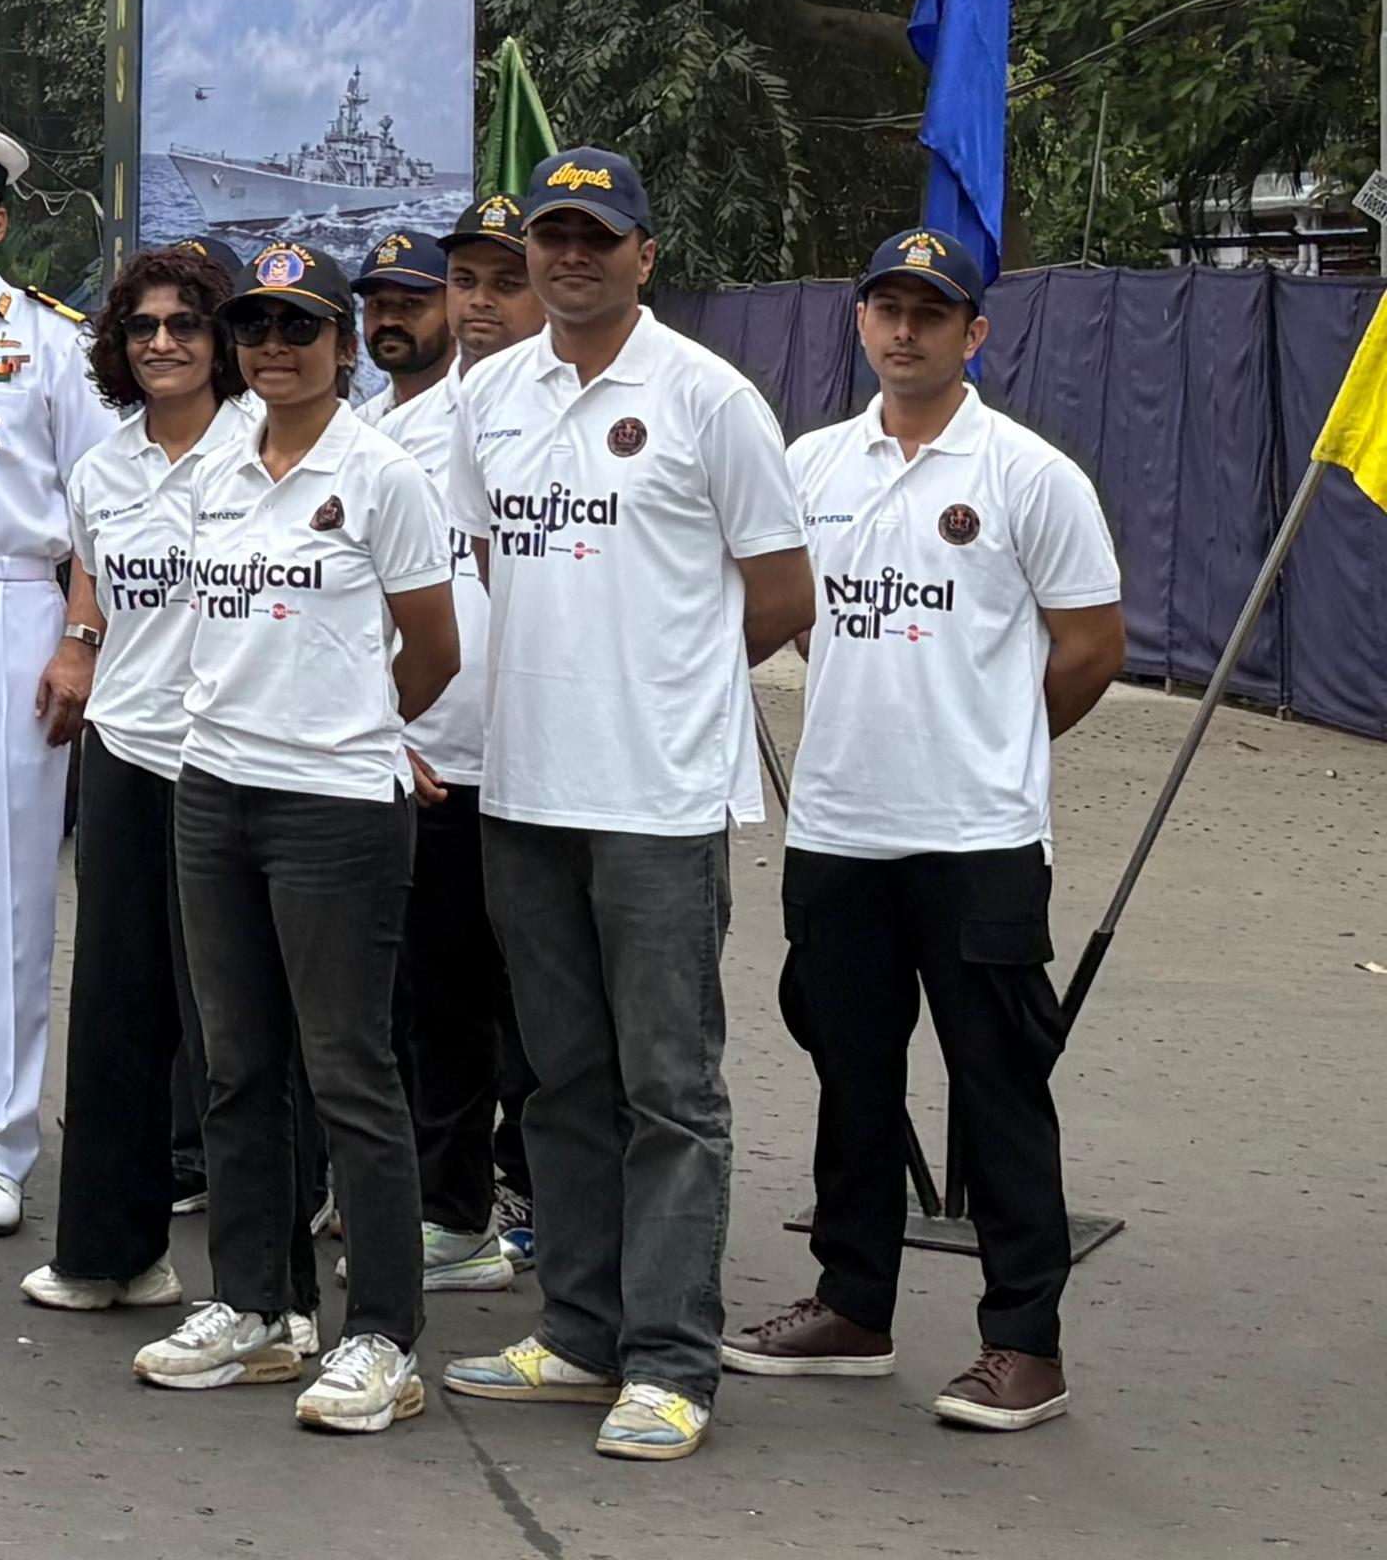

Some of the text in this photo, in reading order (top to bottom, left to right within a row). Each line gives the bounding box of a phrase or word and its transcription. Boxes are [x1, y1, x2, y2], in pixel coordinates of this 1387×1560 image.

[547, 161, 613, 191] Angels
[490, 523, 546, 557] Trail
[194, 553, 321, 594] Nautical
[197, 588, 250, 619] Trail
